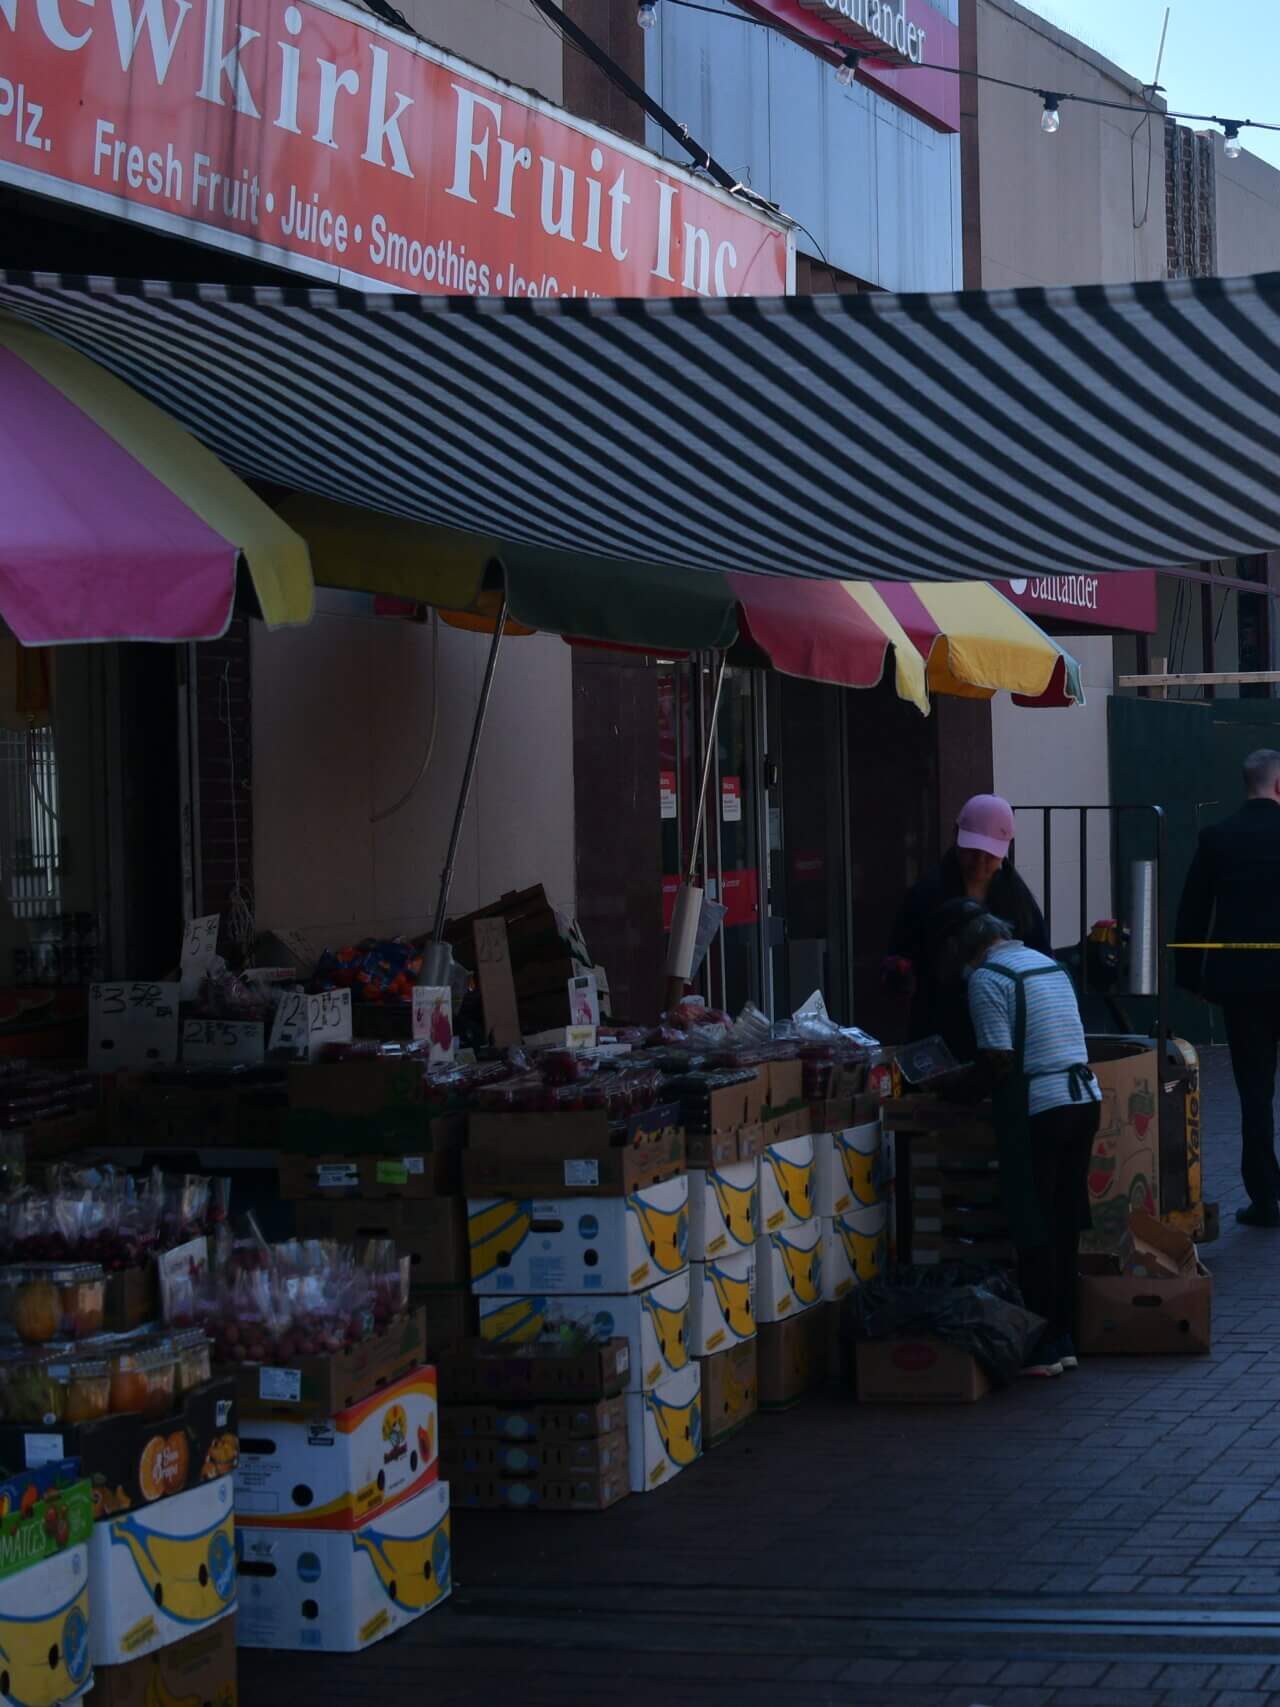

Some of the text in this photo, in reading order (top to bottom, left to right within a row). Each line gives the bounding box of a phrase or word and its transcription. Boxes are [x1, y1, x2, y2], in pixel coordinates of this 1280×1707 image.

[0, 76, 52, 152] Plz.
[444, 82, 631, 262] Fruit
[93, 118, 184, 201] Fresh
[192, 151, 261, 225] Fruit
[281, 184, 349, 253] Juice
[369, 213, 491, 297] Smoothies
[1186, 1095, 1201, 1169] Yale
